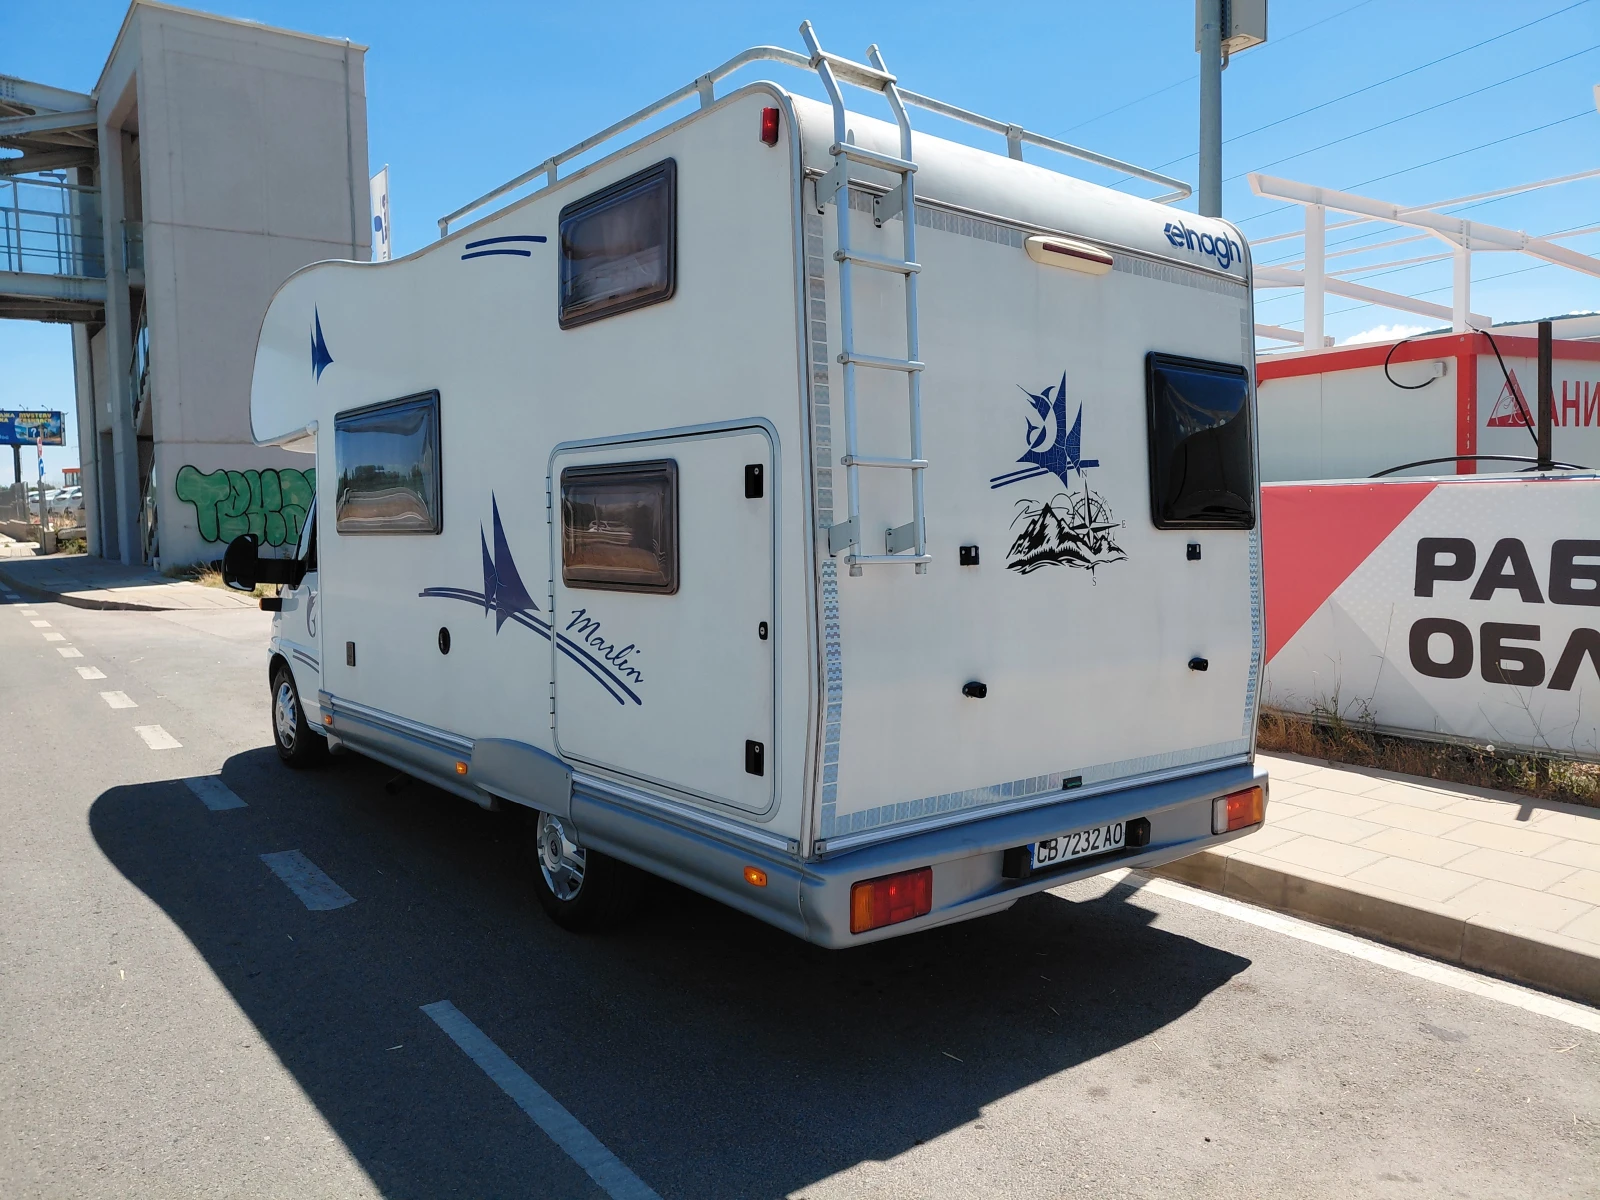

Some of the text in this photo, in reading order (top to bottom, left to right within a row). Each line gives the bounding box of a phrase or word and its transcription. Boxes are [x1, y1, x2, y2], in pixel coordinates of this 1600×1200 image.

[1167, 219, 1242, 270] elnagh
[1081, 469, 1088, 479] N
[1121, 519, 1127, 529] E
[1414, 537, 1600, 606] РАБ
[565, 608, 644, 683] Marlin
[1409, 617, 1600, 691] ОБЛ
[1062, 829, 1100, 858] 7232
